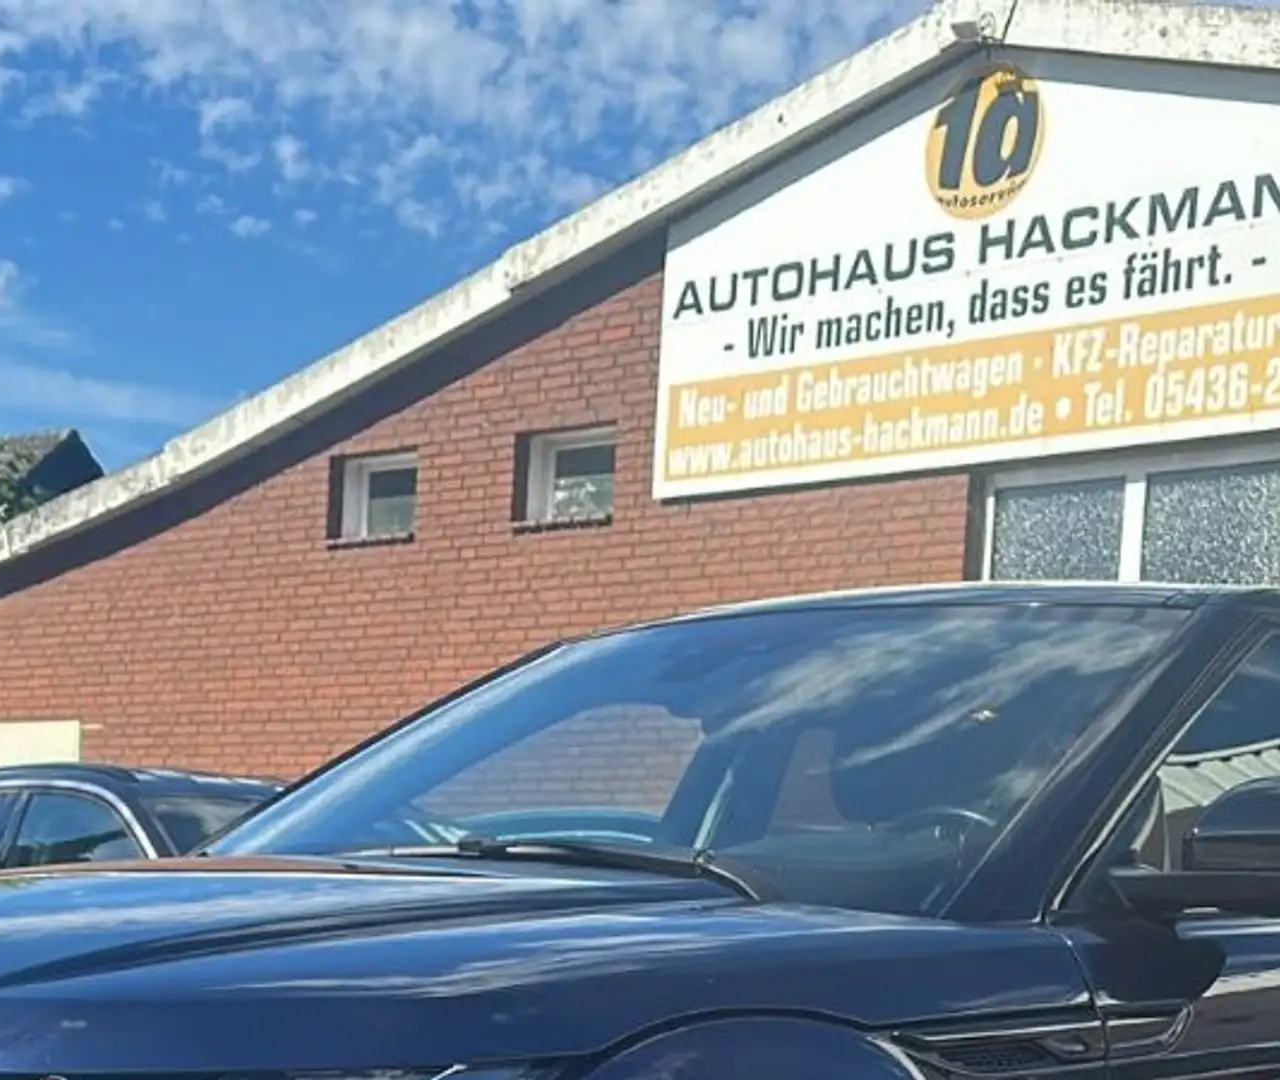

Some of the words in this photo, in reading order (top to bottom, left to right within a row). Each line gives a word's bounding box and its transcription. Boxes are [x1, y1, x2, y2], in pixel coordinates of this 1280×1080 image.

[672, 232, 956, 320] AUTOHAUS
[748, 313, 805, 359] Wir
[816, 296, 956, 350] machen,
[968, 279, 1050, 325] dass
[1065, 271, 1108, 309] es
[1123, 244, 1233, 300] fährt.
[668, 393, 1045, 477] www.autohaus-hackmann.de
[1084, 380, 1133, 427] Tel.
[679, 388, 736, 429] Neu-
[743, 375, 788, 421] und
[796, 352, 1024, 414] Gebrauchtwagen
